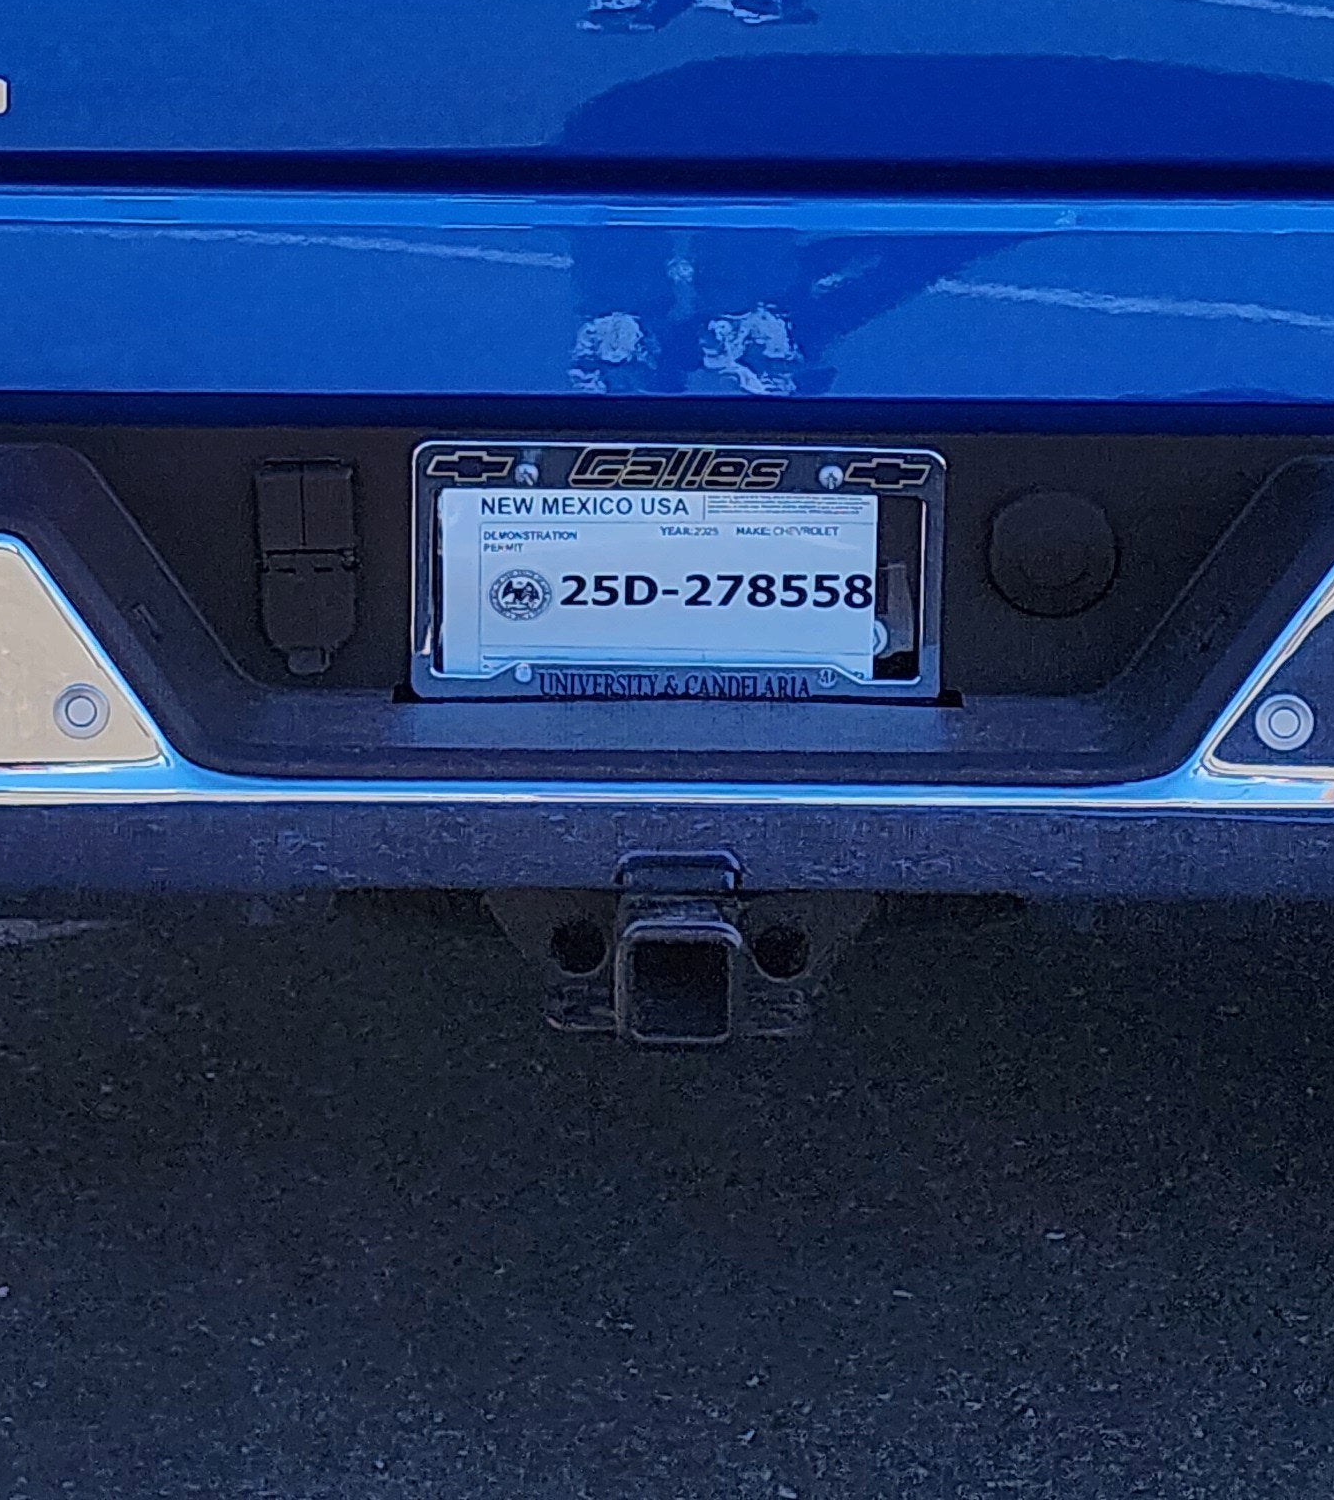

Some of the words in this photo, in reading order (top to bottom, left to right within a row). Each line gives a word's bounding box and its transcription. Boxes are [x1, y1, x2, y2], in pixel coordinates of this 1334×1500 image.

[568, 447, 789, 489] Galles
[481, 497, 533, 515] NEW
[542, 497, 633, 515] MEXICO
[641, 497, 689, 516] USA
[483, 531, 578, 541] DEMONSTRATION
[560, 574, 874, 609] 25D-278558
[539, 671, 659, 696] UNIVERSITY
[666, 674, 680, 696] &
[686, 672, 811, 698] CANDELARIA
